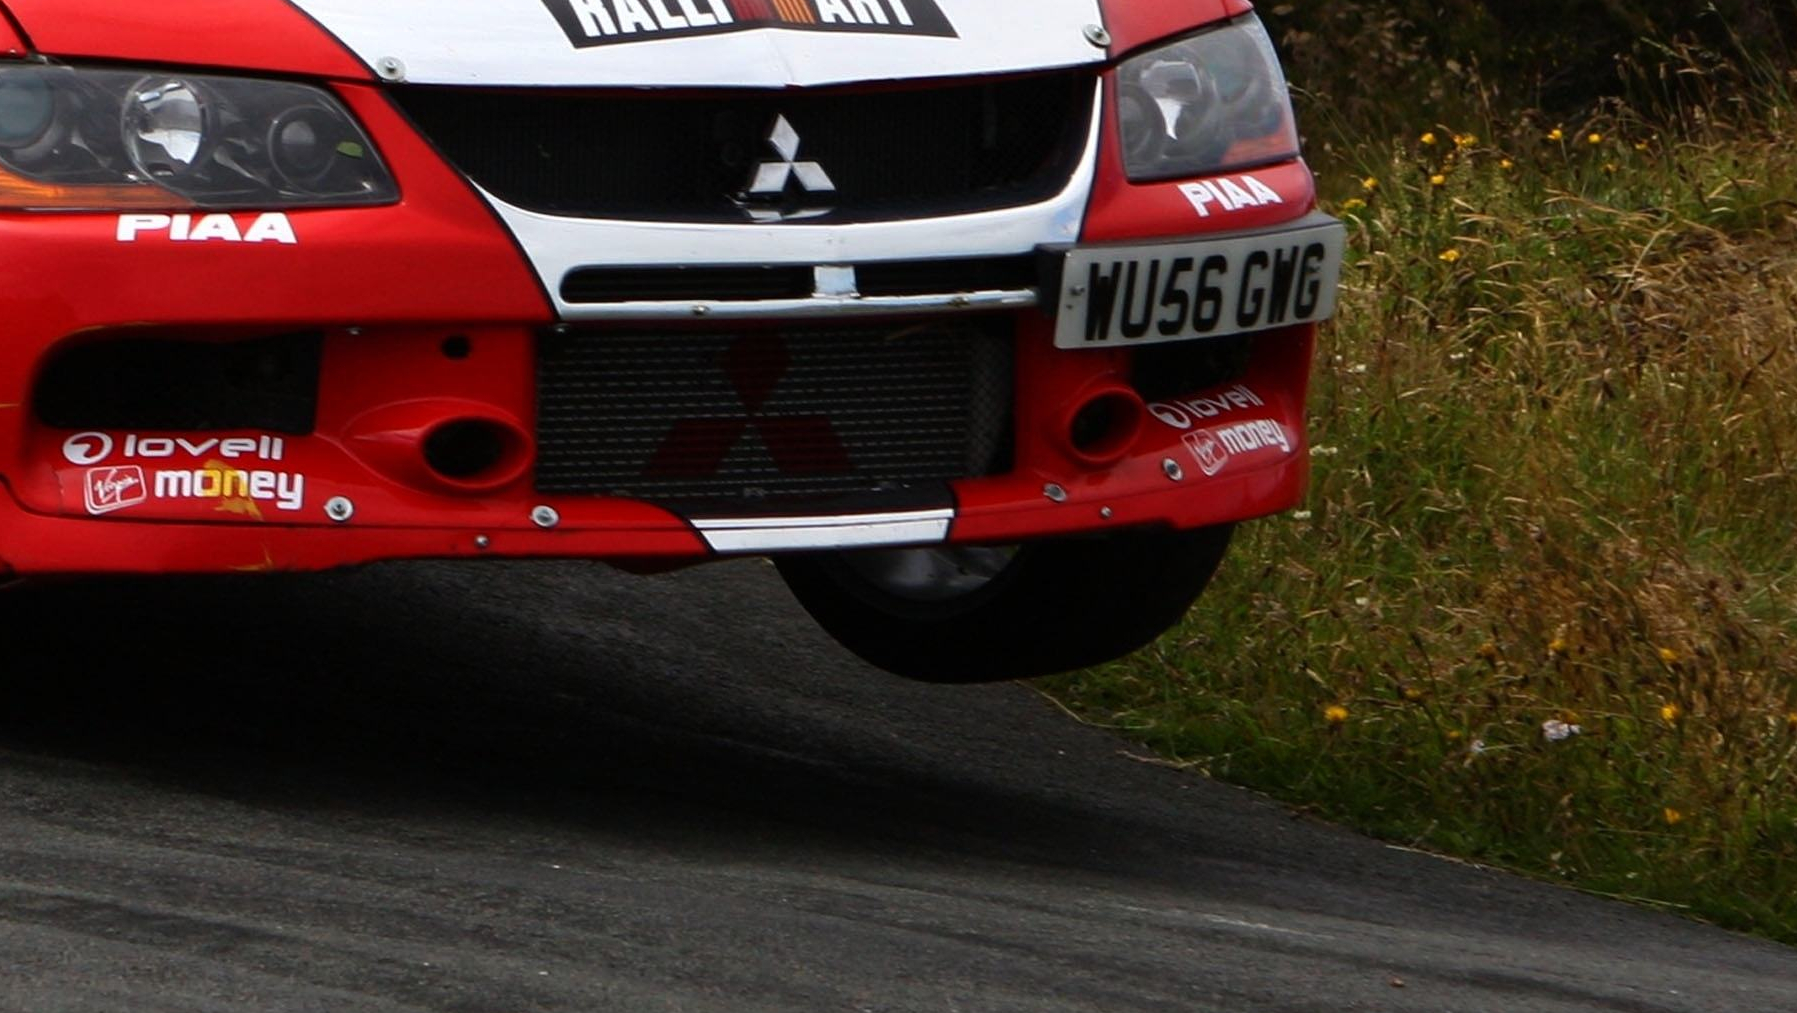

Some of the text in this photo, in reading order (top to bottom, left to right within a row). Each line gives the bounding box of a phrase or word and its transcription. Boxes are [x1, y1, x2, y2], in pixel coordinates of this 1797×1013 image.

[1175, 175, 1283, 217] PIAA
[116, 212, 298, 244] PIAA
[1084, 242, 1326, 341] WU56 GWG
[1173, 384, 1265, 419] lovell
[124, 434, 283, 460] lovell
[1216, 418, 1291, 455] money
[155, 470, 303, 510] money
